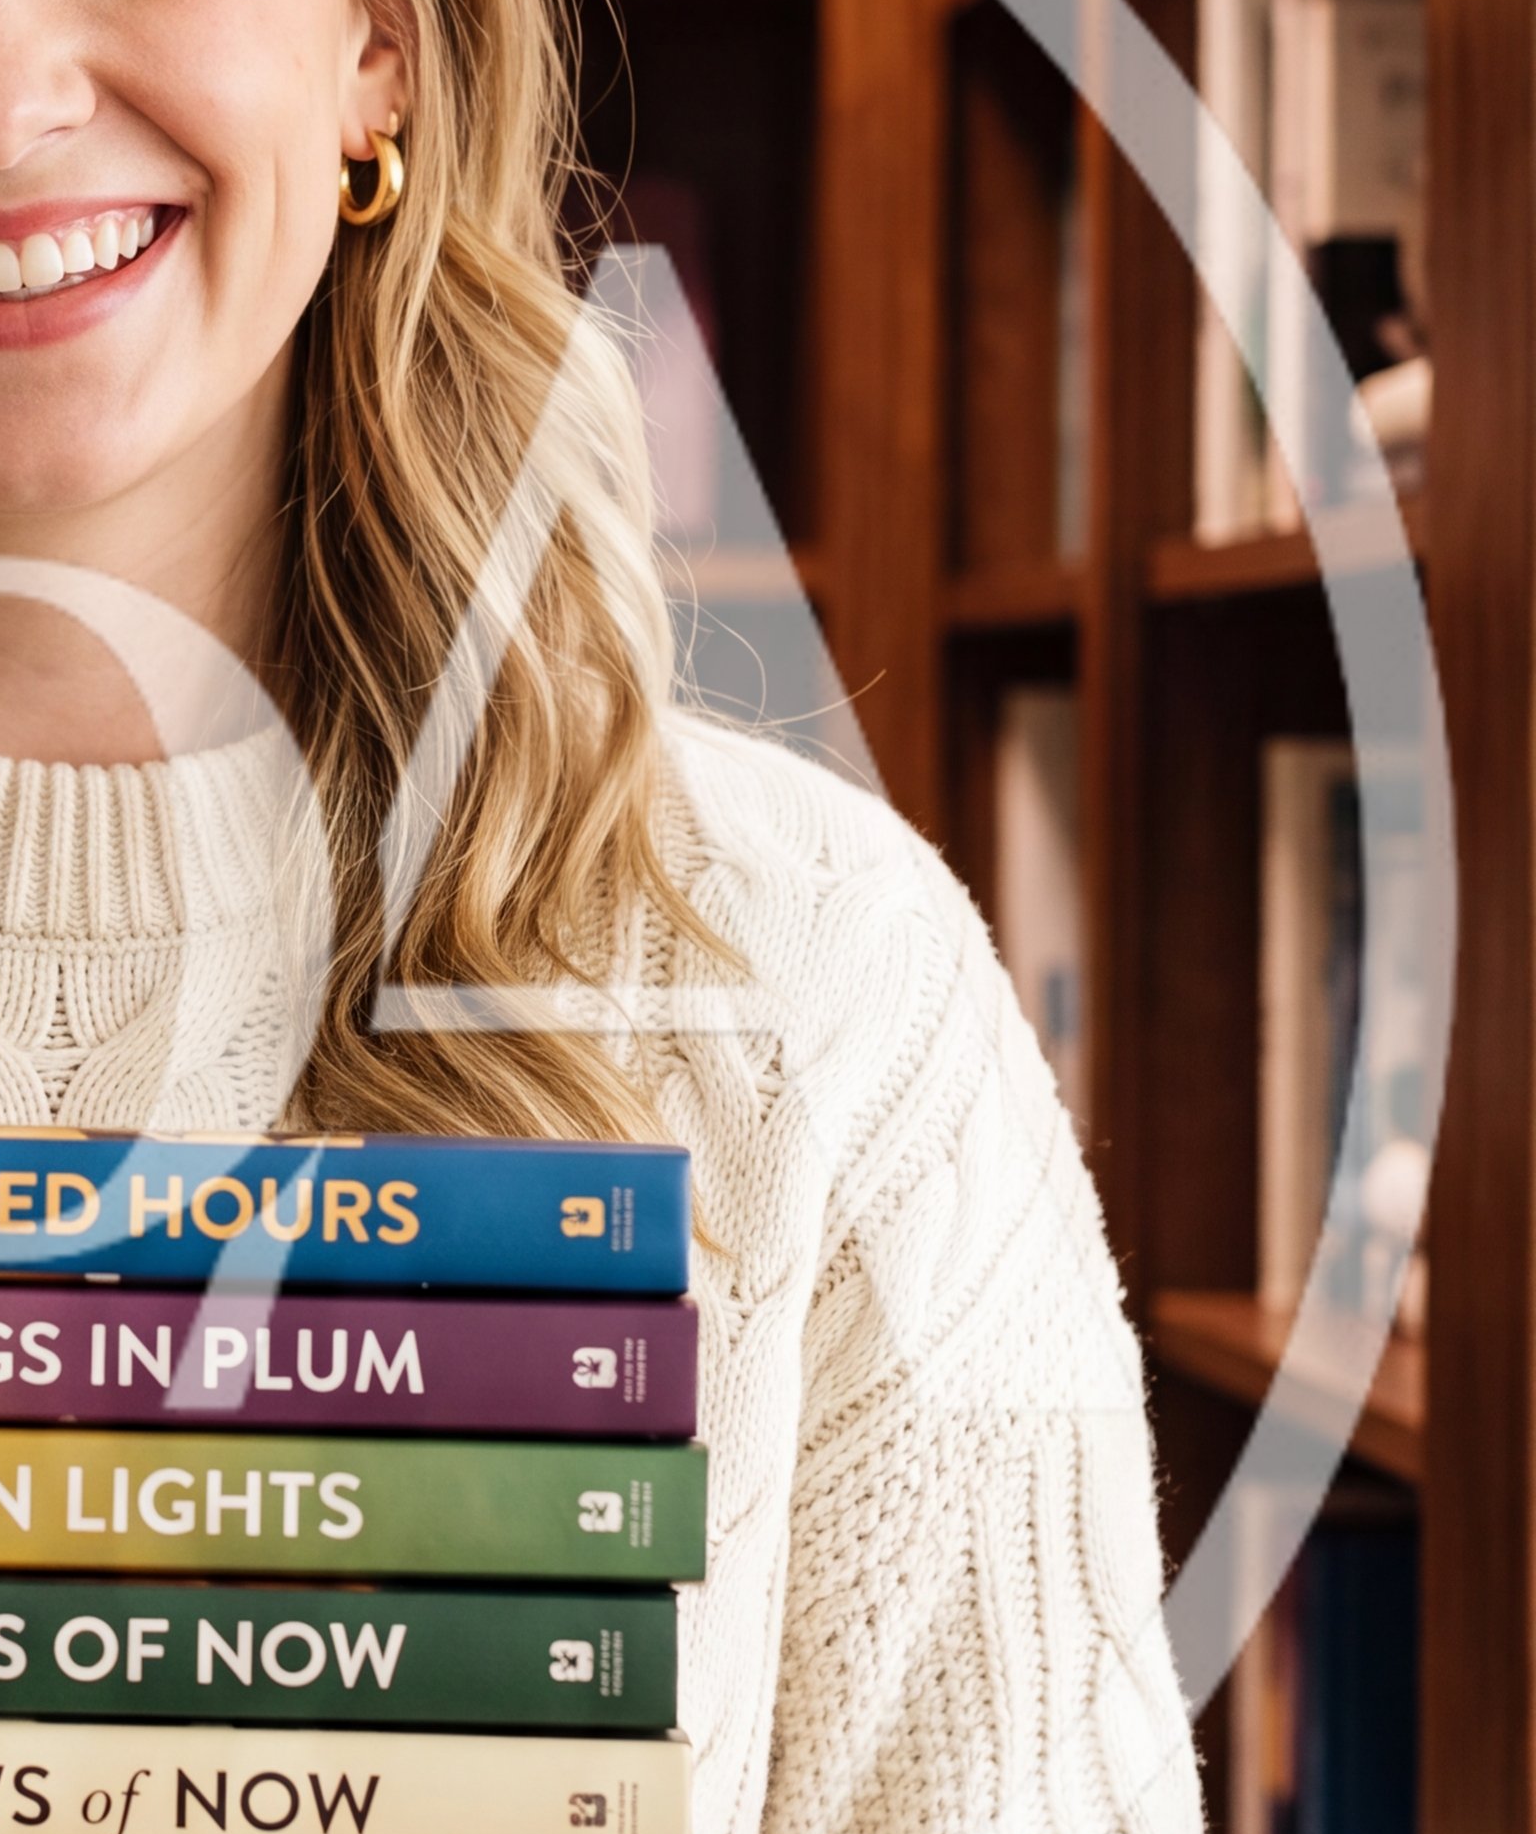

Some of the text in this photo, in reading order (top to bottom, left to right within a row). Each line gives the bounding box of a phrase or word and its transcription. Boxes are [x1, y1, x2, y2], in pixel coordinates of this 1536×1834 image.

[129, 1174, 418, 1243] HOURS
[91, 1324, 170, 1387] IN
[203, 1326, 423, 1393] PLUM
[67, 1466, 363, 1539] LIGHTS
[54, 1616, 169, 1681] OF
[198, 1619, 406, 1688] NOW
